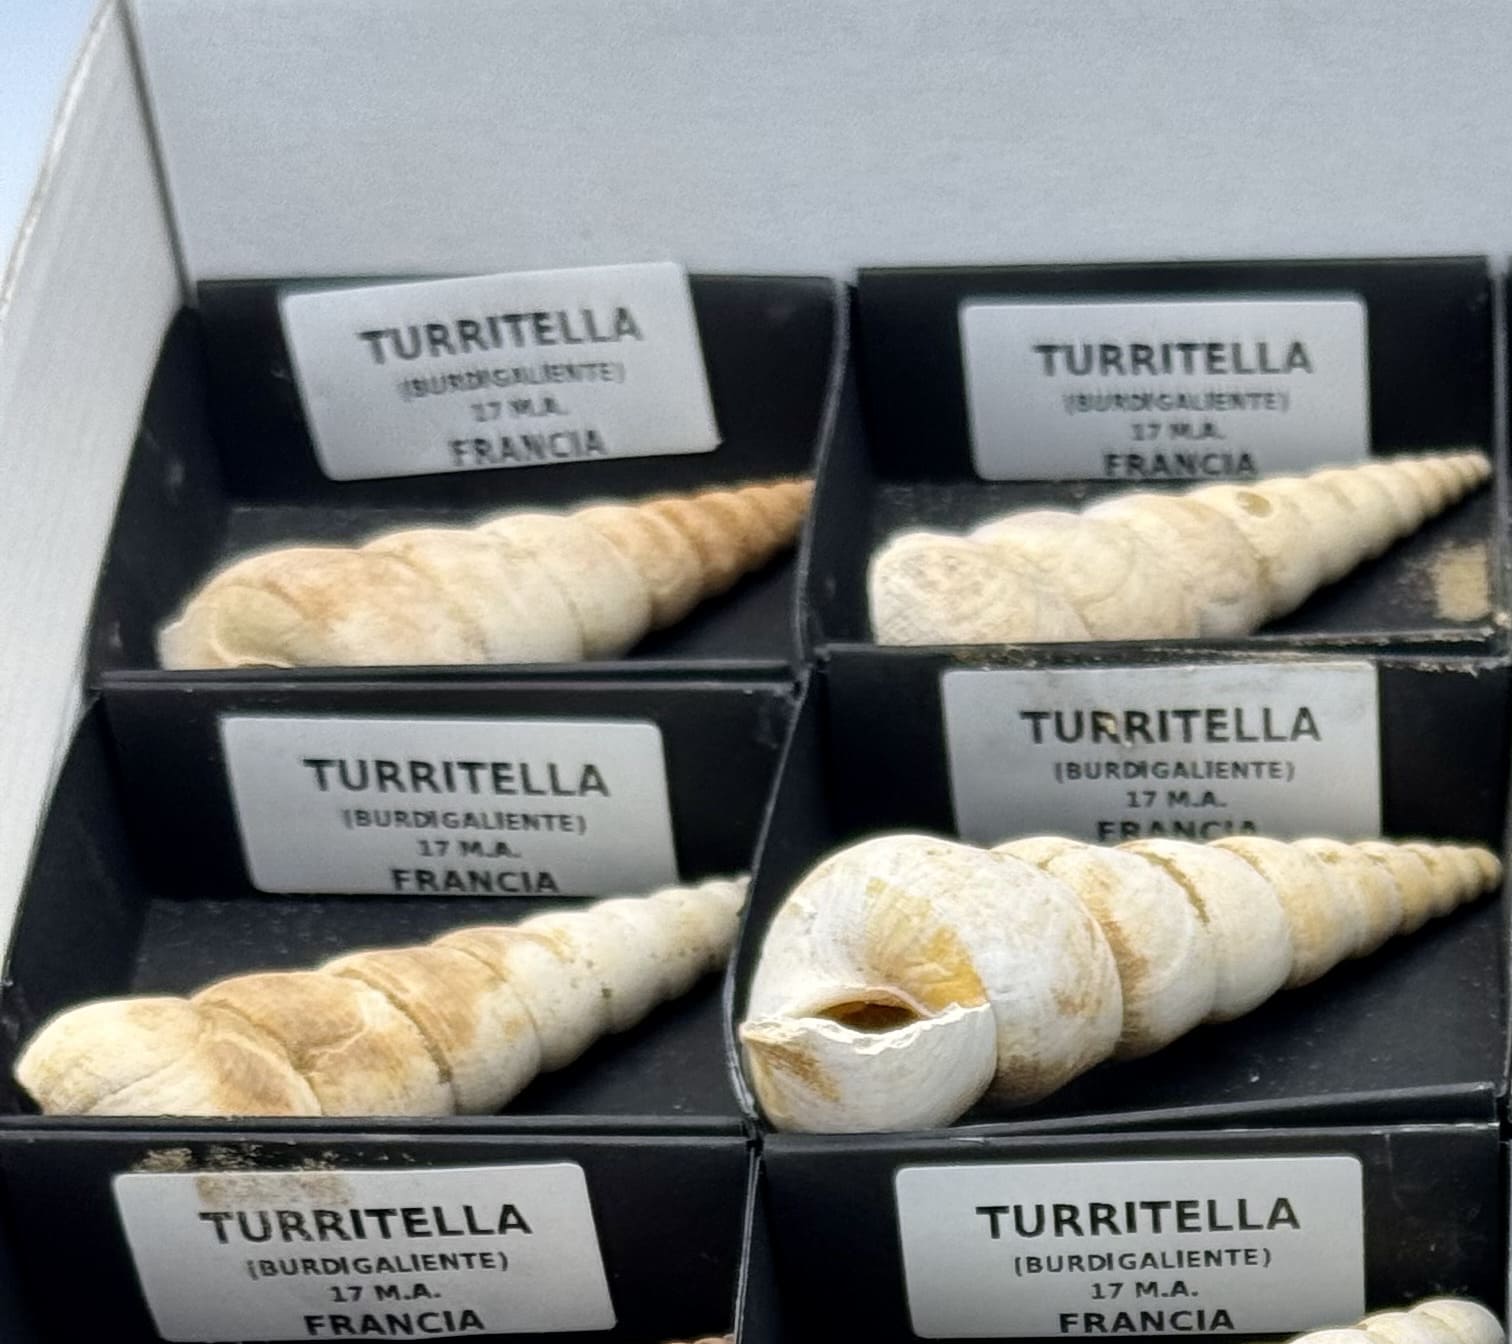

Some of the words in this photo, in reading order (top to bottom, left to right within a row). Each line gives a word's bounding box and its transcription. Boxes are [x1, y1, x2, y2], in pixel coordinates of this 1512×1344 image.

[359, 307, 642, 363] TURRITELLA
[1034, 342, 1315, 376] TURRITELLA
[398, 362, 625, 401] (BURDIGALIENTE)
[474, 400, 504, 422] 17
[1063, 391, 1289, 413] (BURDIGALIENTE)
[1131, 423, 1160, 441] 17
[447, 430, 605, 467] FRANCIA
[1103, 453, 1260, 478] FRANCIA
[1021, 707, 1321, 745] TURRITELLA
[304, 757, 609, 797] TURRITELLA
[1055, 760, 1294, 783] (BURDIGALIENTE)
[1126, 791, 1156, 809] 17
[1167, 791, 1226, 809] M.A.
[342, 808, 587, 833] (BURDIGALIENTE)
[417, 840, 448, 857] 17
[457, 841, 520, 859] M.A.
[392, 867, 559, 893] FRANCIA
[200, 1203, 531, 1245] TURRITELLA
[976, 1198, 1300, 1241] TURRITELLA
[247, 1252, 508, 1281] (BURDIGALIENTE)
[1014, 1247, 1272, 1277] (BURDIGALIENTE)
[329, 1283, 362, 1303] 17
[375, 1283, 441, 1302] M.A.
[1090, 1282, 1124, 1301] 17
[1135, 1279, 1198, 1299] M.A.
[304, 1309, 485, 1336] FRANCIA
[1058, 1305, 1234, 1334] FRANCIA
